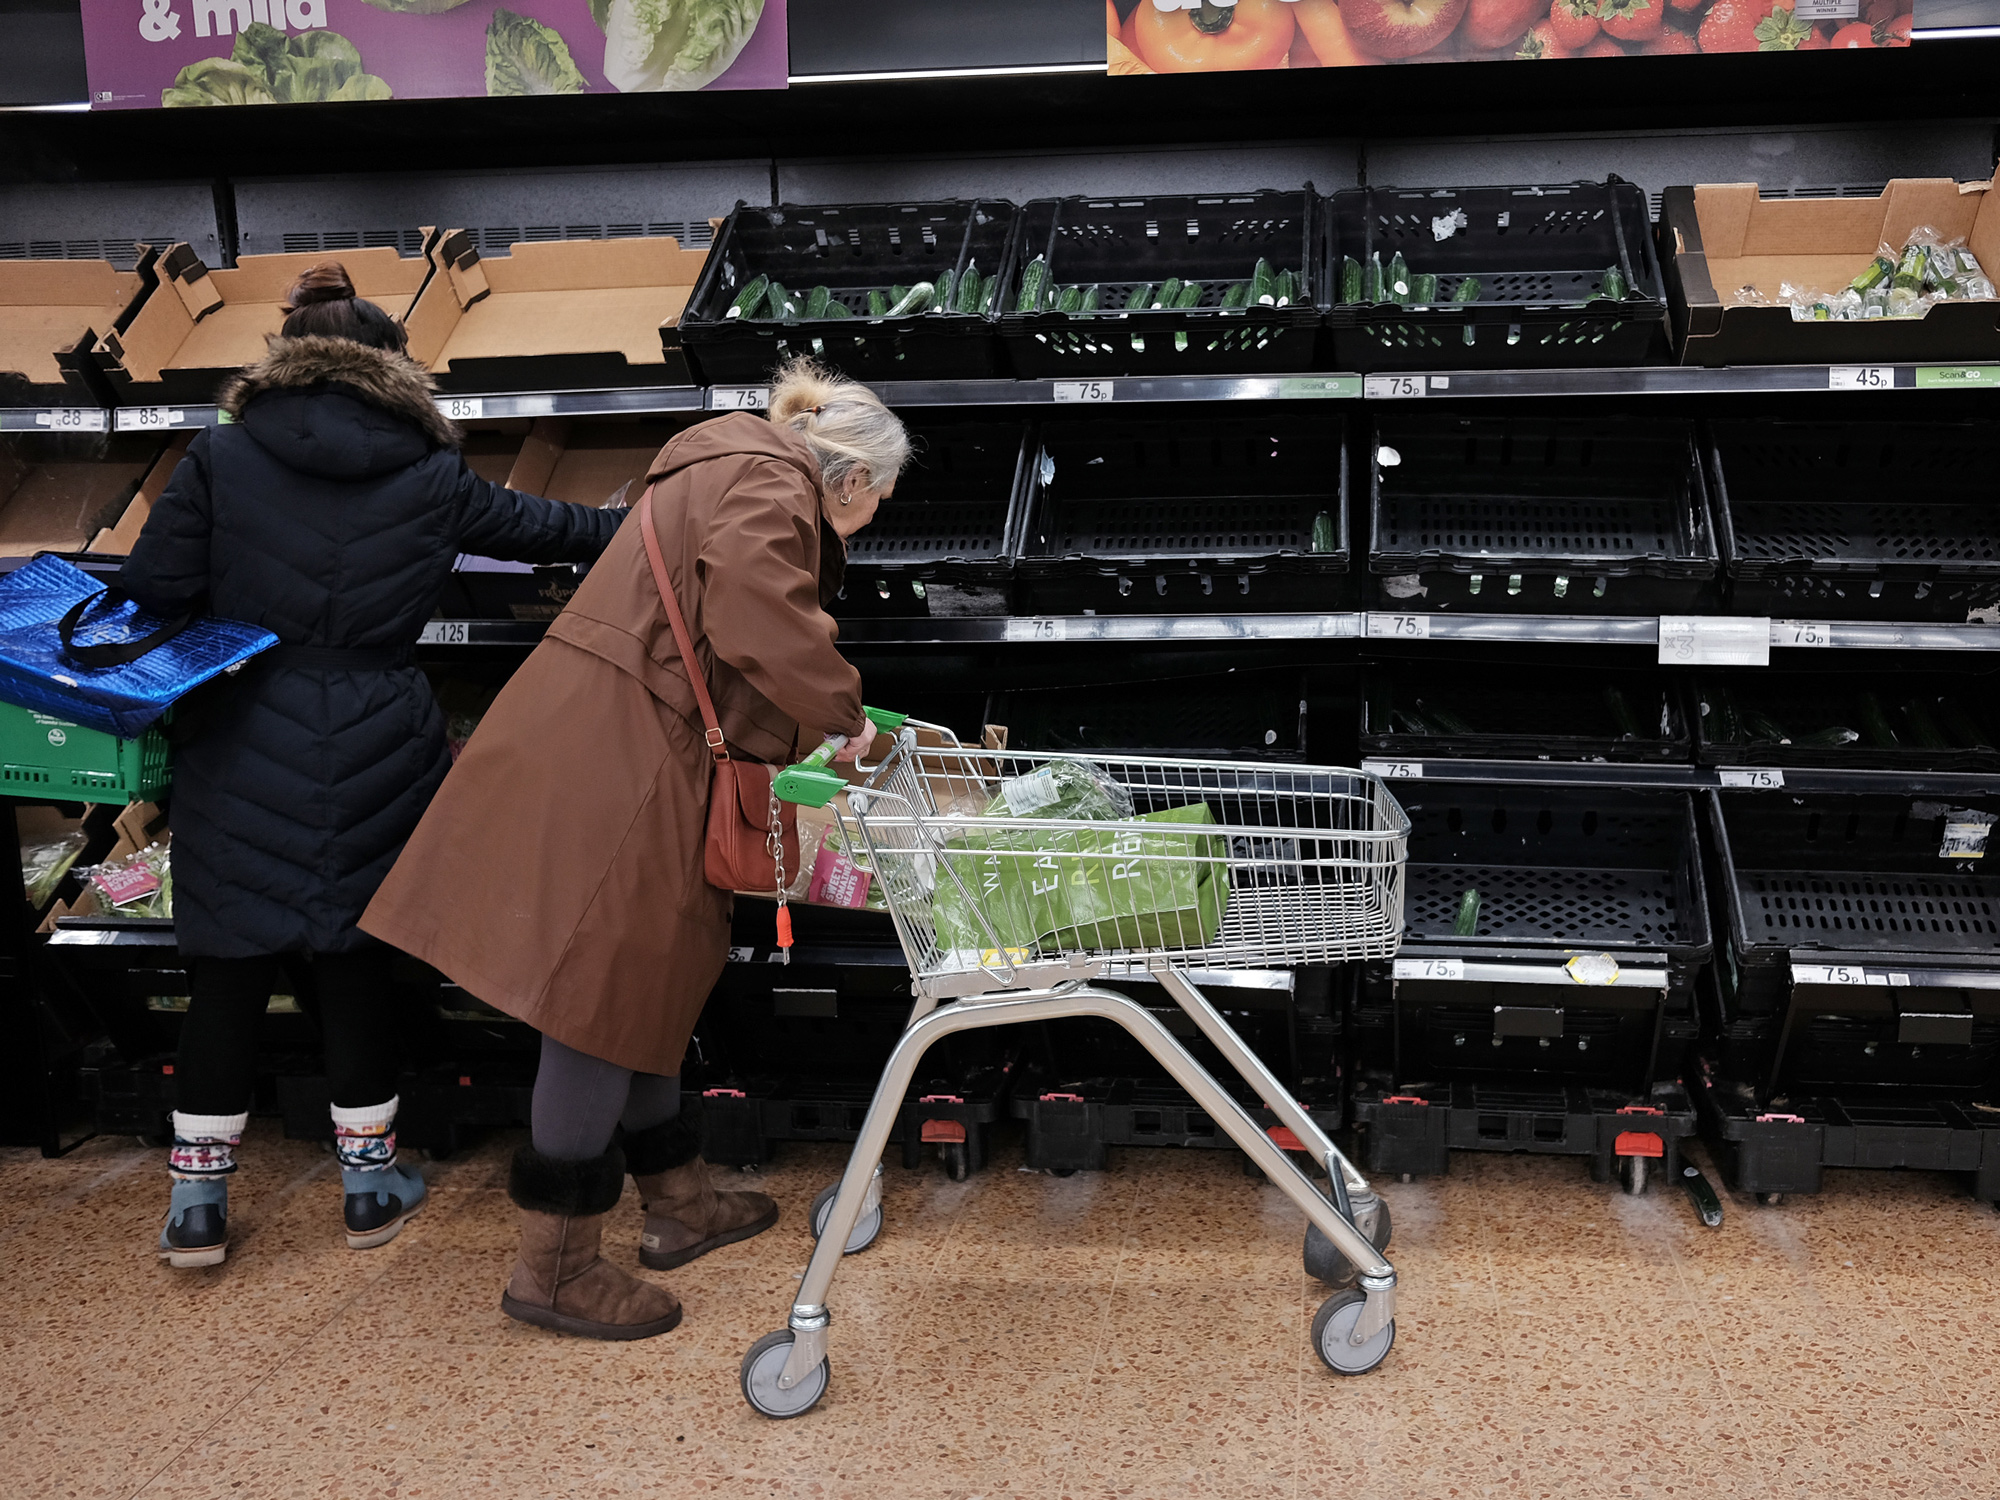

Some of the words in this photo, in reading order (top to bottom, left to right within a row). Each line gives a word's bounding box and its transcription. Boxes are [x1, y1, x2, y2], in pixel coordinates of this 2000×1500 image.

[138, 0, 182, 42] &
[1856, 368, 1888, 388] 45p
[1939, 370, 1981, 379] Scan&GO
[1079, 383, 1108, 401] 75p
[1300, 382, 1339, 390] Scan&GO
[1389, 378, 1420, 396] 75p
[736, 390, 763, 408] 75p
[139, 409, 165, 425] 85p
[452, 400, 477, 418] 85p
[1032, 621, 1061, 640] 75p
[1393, 616, 1423, 636] 75p
[1793, 625, 1824, 646] 75p
[1747, 773, 1779, 787] 75p
[825, 866, 843, 902] SWEET
[836, 858, 846, 866] &
[842, 874, 858, 907] HEARTS
[1422, 960, 1456, 978] 75p
[1822, 966, 1859, 985] 75p
